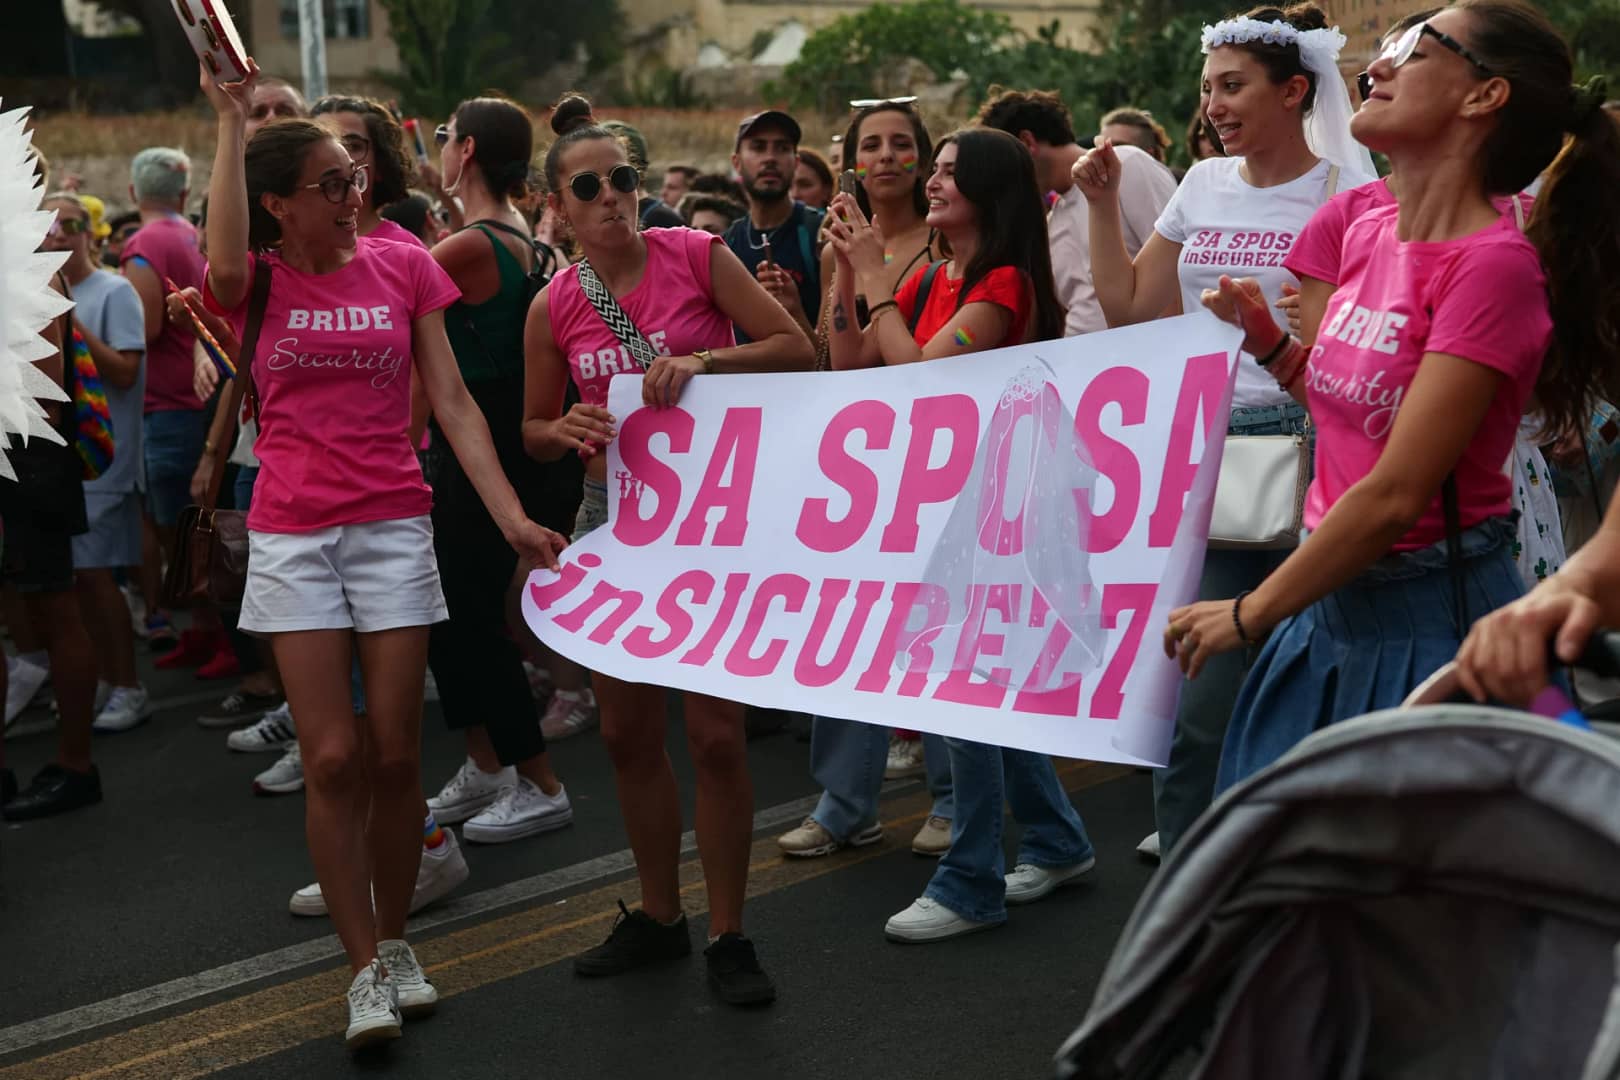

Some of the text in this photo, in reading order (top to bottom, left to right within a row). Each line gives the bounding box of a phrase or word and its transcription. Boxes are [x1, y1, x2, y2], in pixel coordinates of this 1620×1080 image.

[1192, 231, 1222, 249] SA
[286, 305, 393, 331] BRIDE
[266, 337, 403, 389] Security
[578, 330, 672, 380] BRIE
[611, 351, 1229, 556] SA SPOSA
